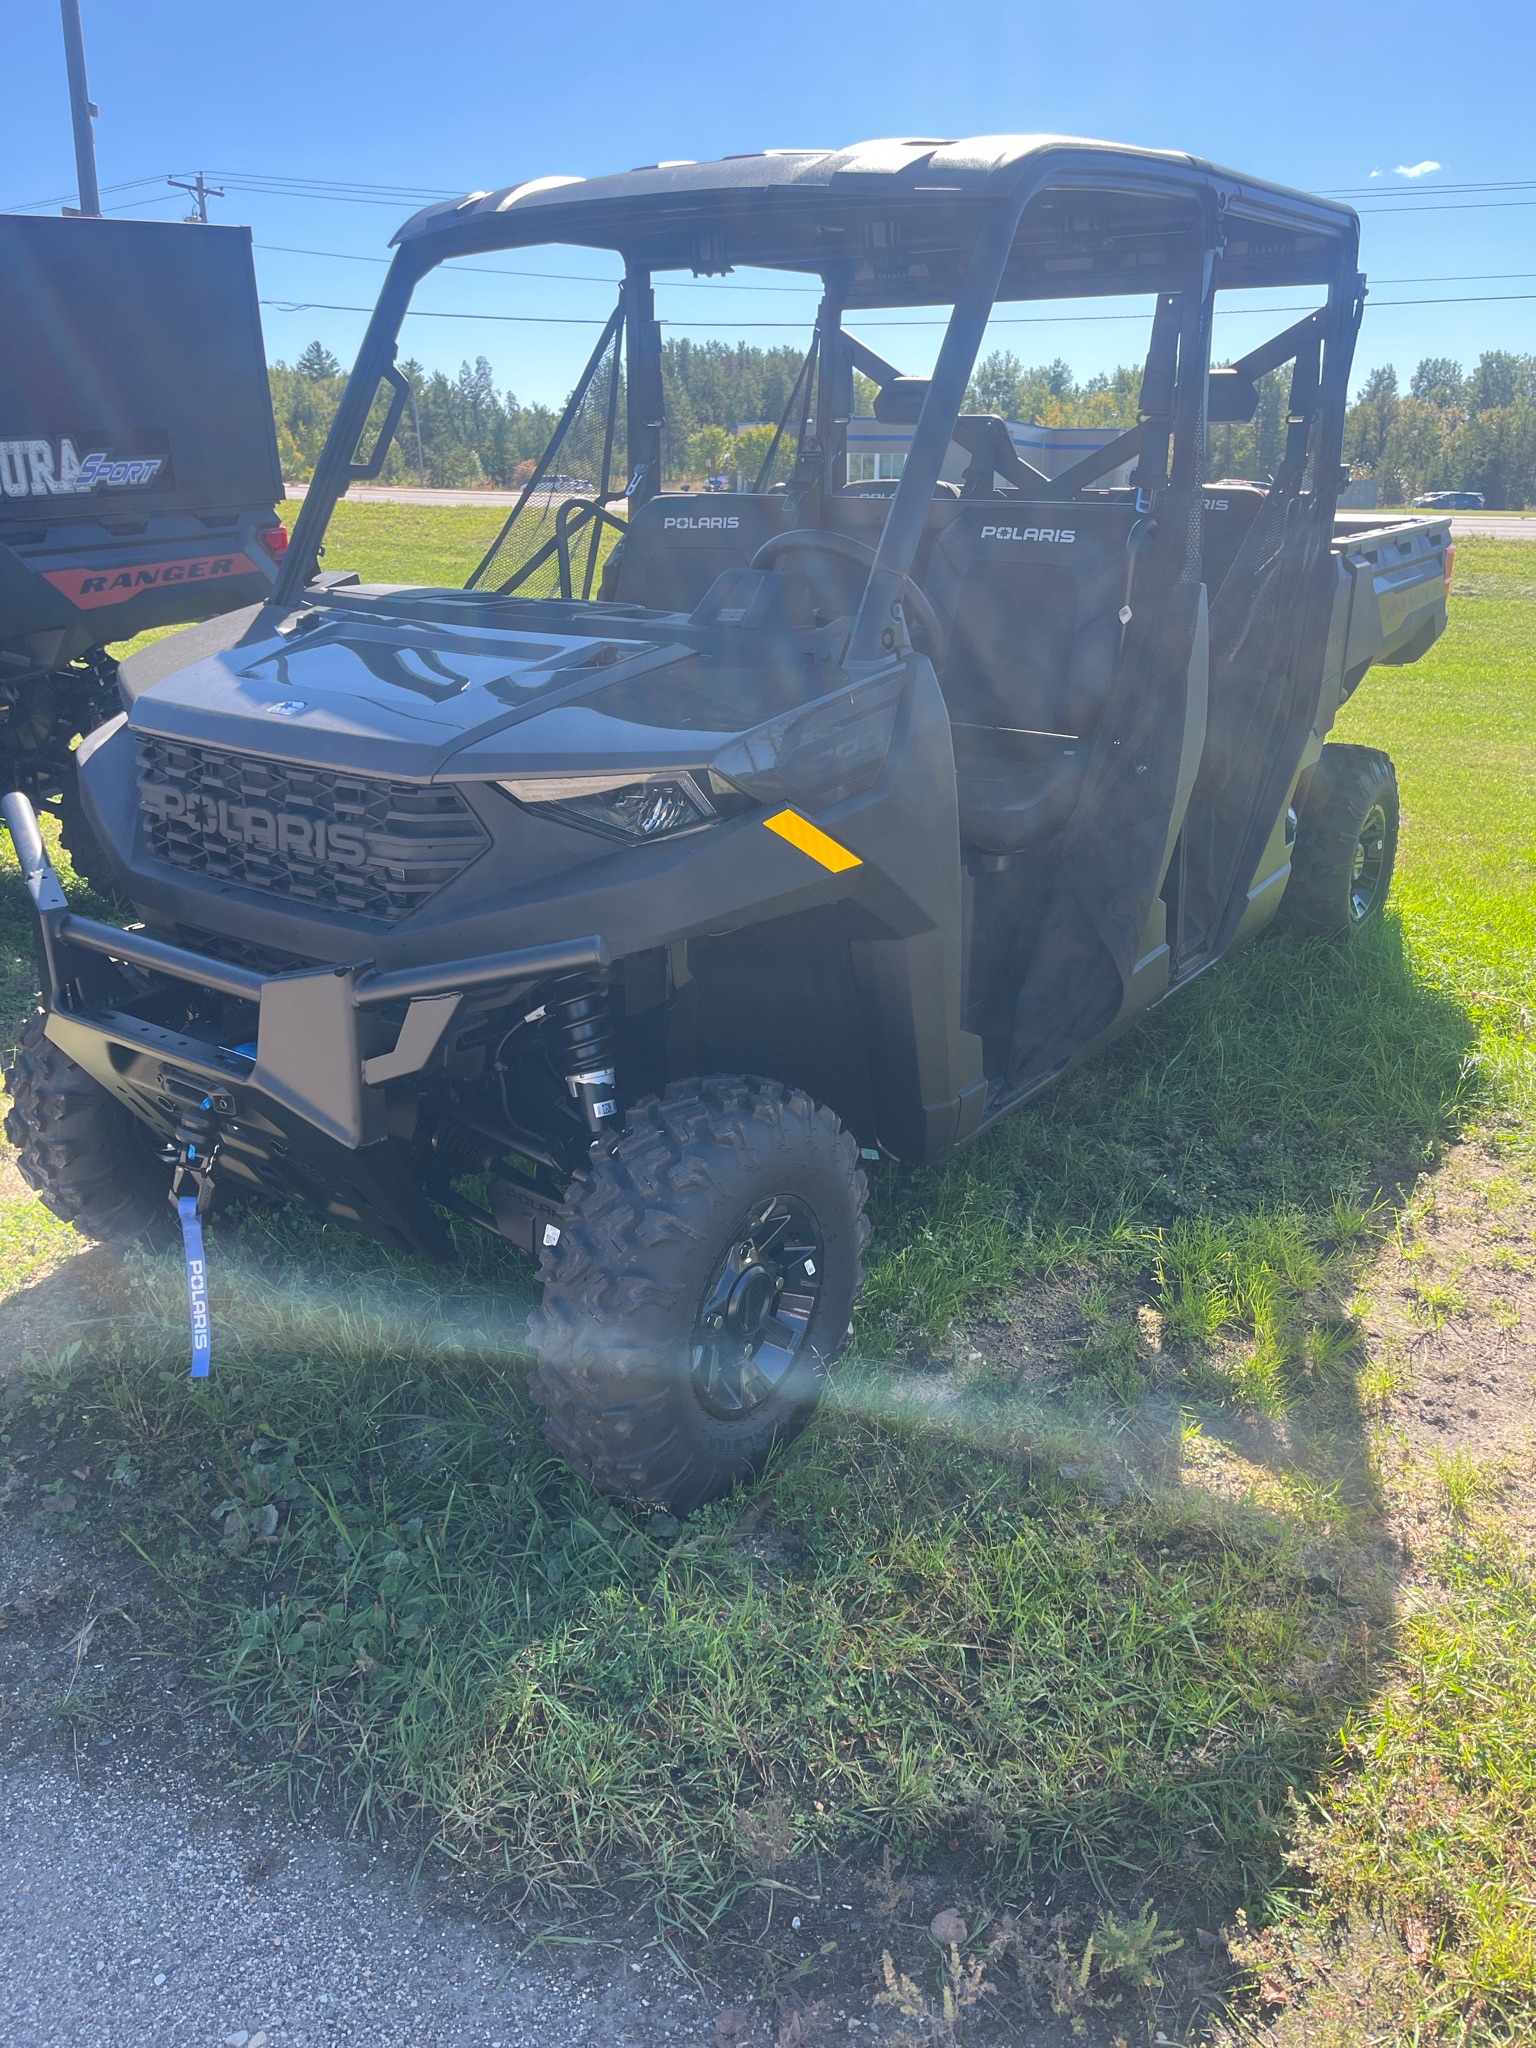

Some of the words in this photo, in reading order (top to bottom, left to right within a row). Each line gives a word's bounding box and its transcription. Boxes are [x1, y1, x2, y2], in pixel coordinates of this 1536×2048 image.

[663, 516, 740, 530] POLARIS
[980, 525, 1076, 544] POLARIS
[80, 558, 234, 595] RANGER
[147, 783, 369, 866] POLARIS
[188, 1259, 208, 1351] POLARIS
